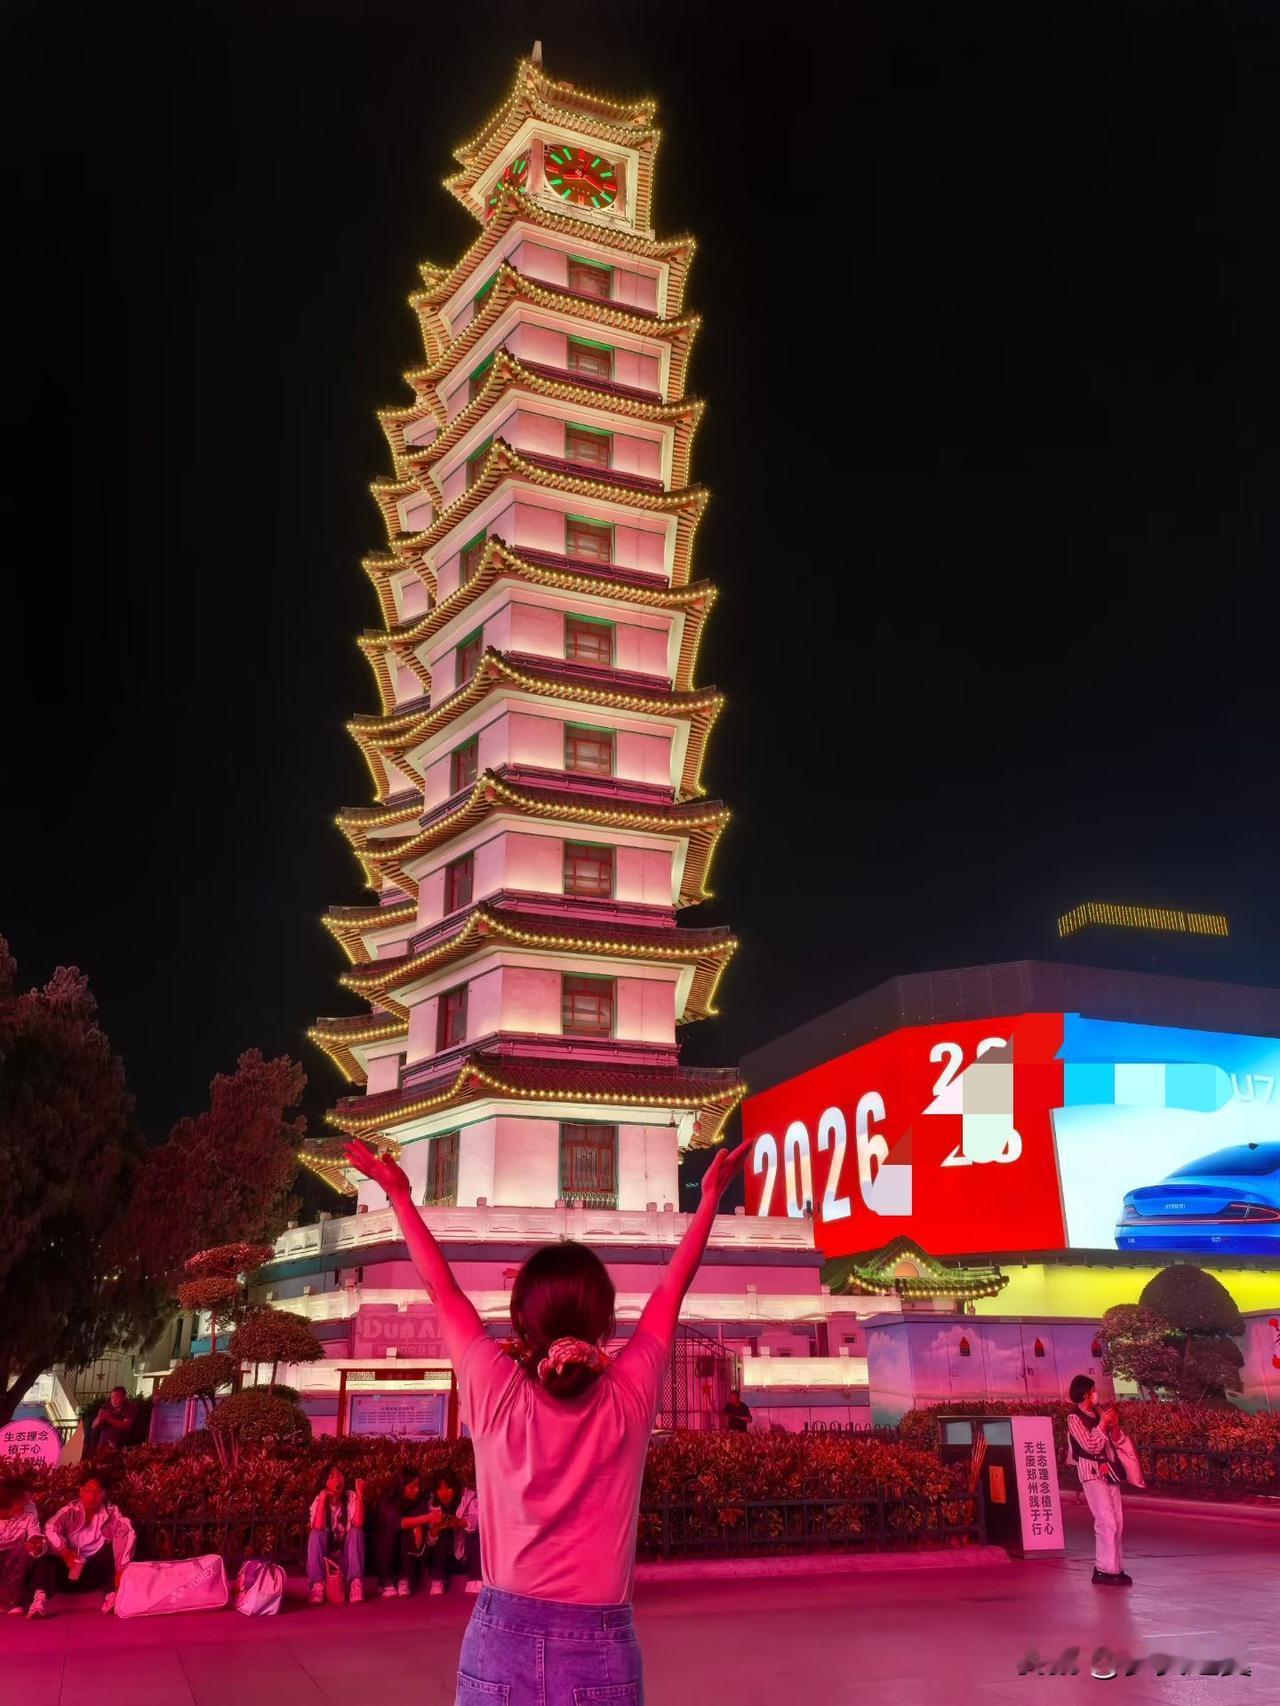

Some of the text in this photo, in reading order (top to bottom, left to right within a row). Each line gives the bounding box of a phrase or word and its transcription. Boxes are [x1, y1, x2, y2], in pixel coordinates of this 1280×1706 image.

[4, 1431, 49, 1442] 生态理念
[1024, 1441, 1042, 1536] 无废郑州践于行
[1036, 1441, 1054, 1535] 生态理念植于心
